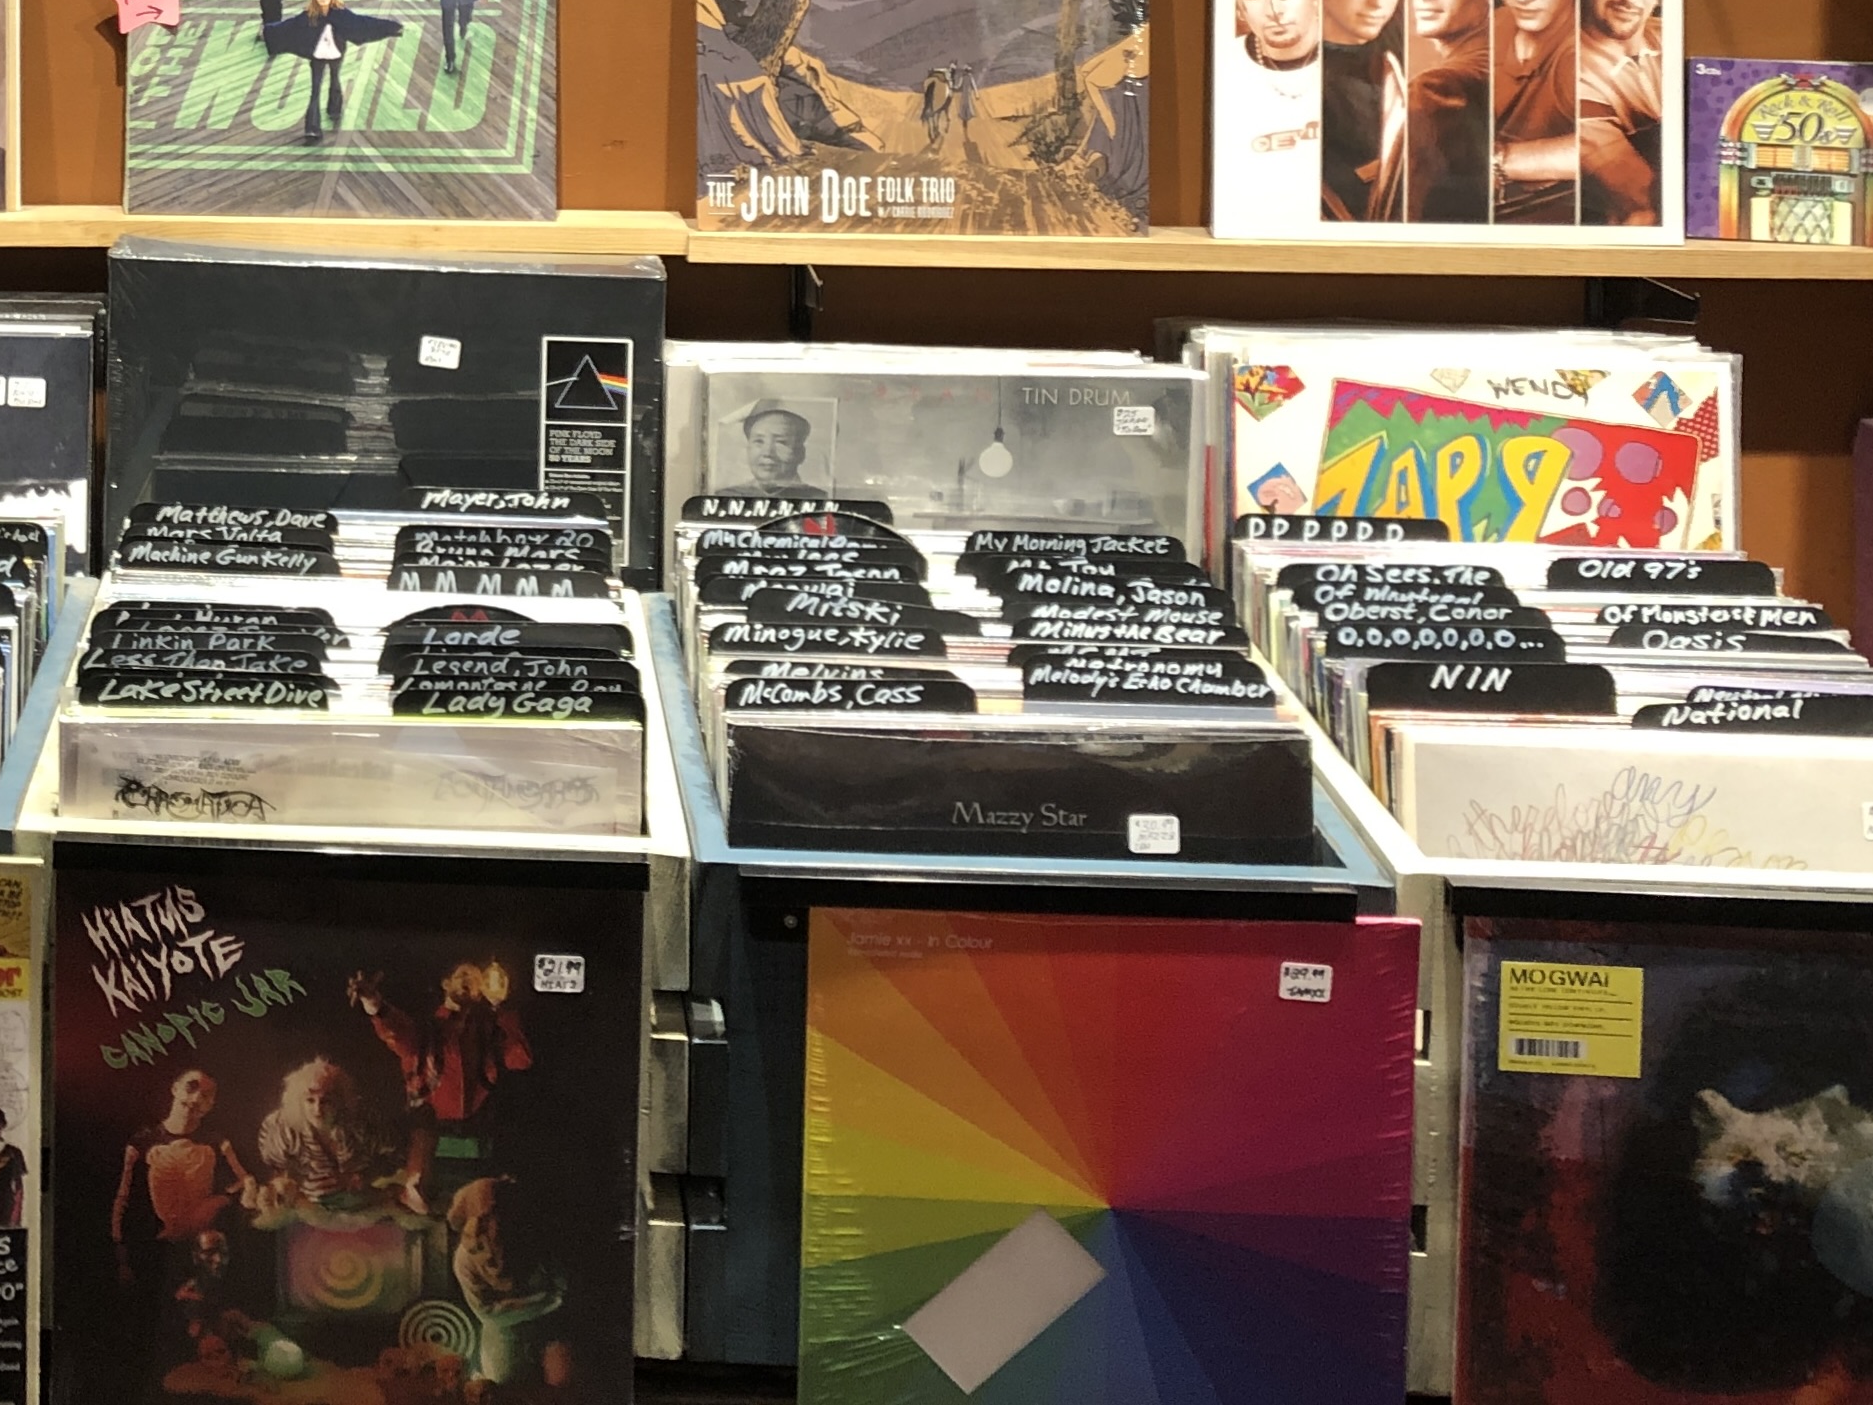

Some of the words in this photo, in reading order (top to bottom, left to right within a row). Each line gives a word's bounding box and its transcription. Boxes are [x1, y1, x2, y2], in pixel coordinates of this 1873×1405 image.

[706, 181, 735, 208] THE
[740, 168, 810, 222] JOHN
[819, 168, 872, 222] DOE
[876, 176, 916, 203] FOLK
[919, 175, 956, 203] TRIO
[1021, 386, 1060, 405] TIN
[1069, 386, 1131, 406] DRUM
[1485, 376, 1590, 403] WENDY
[156, 503, 276, 527] Matthews,
[275, 507, 328, 529] Dave
[974, 532, 1008, 552] My
[1011, 534, 1087, 557] Morning
[1089, 535, 1171, 555] Jacket
[128, 541, 212, 565] Machine
[215, 545, 259, 566] Gun
[262, 550, 318, 576] Kelly
[1578, 560, 1632, 580] Old
[1643, 559, 1703, 580] 97's
[785, 591, 904, 626] Mitski
[1324, 603, 1427, 624] Oberst,
[1429, 603, 1514, 622] Conor
[1759, 608, 1817, 628] Men
[112, 631, 197, 651] Linkin
[208, 632, 277, 651] Park
[421, 625, 522, 647] Lorde
[1641, 628, 1748, 652] Oasis
[413, 657, 521, 677] Legend,
[523, 659, 589, 677] John
[1429, 664, 1513, 692] NIN
[98, 679, 181, 702] Lake
[181, 679, 264, 704] Street
[264, 681, 325, 708] Dive
[421, 693, 507, 719] Lady
[511, 692, 594, 721] Gaga
[1661, 699, 1806, 727] National
[950, 799, 1034, 833] Mazzy
[1039, 801, 1089, 828] Star
[81, 883, 205, 958] HIATUS
[92, 929, 246, 1017] KAIYOTE
[1509, 967, 1610, 988] MOGWAI
[98, 1000, 226, 1069] CANOPIC
[230, 968, 307, 1019] JAR
